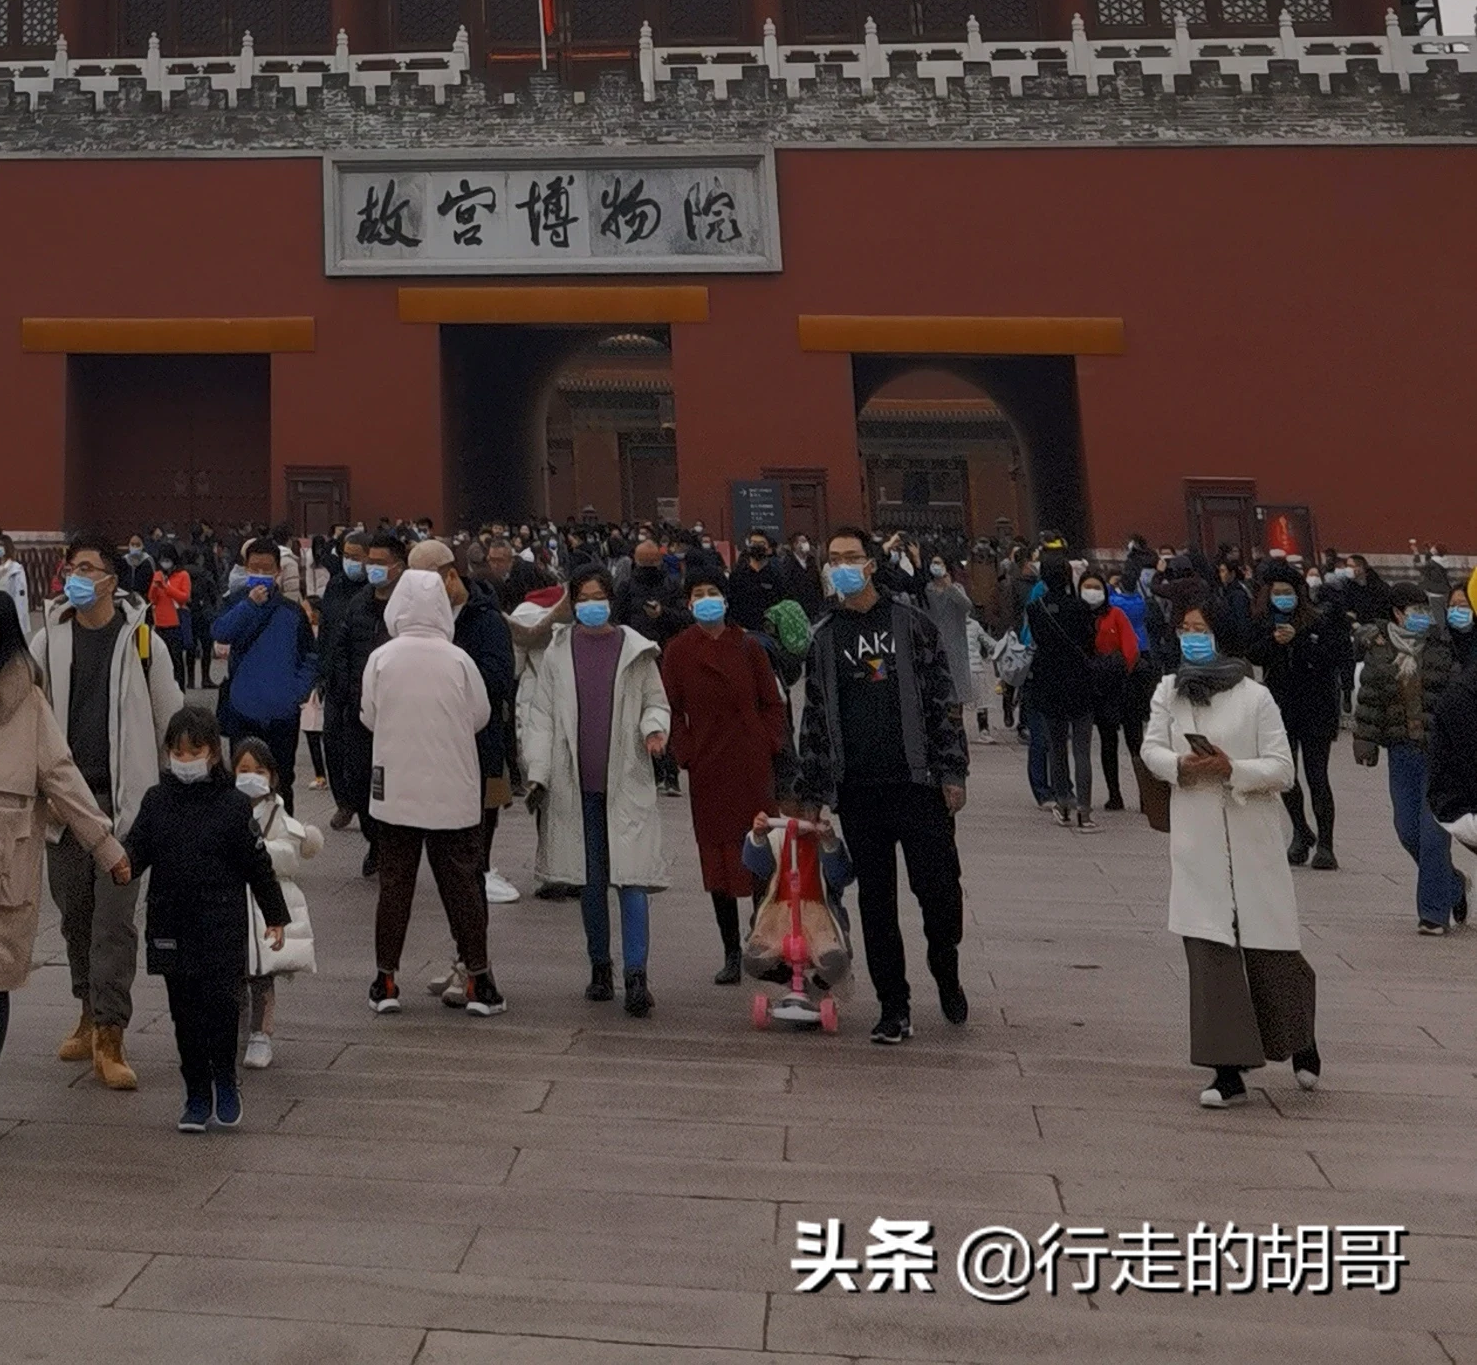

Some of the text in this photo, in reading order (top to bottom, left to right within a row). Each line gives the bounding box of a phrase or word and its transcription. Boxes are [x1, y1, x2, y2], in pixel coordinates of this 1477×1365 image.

[355, 174, 744, 249] 故宫博物院
